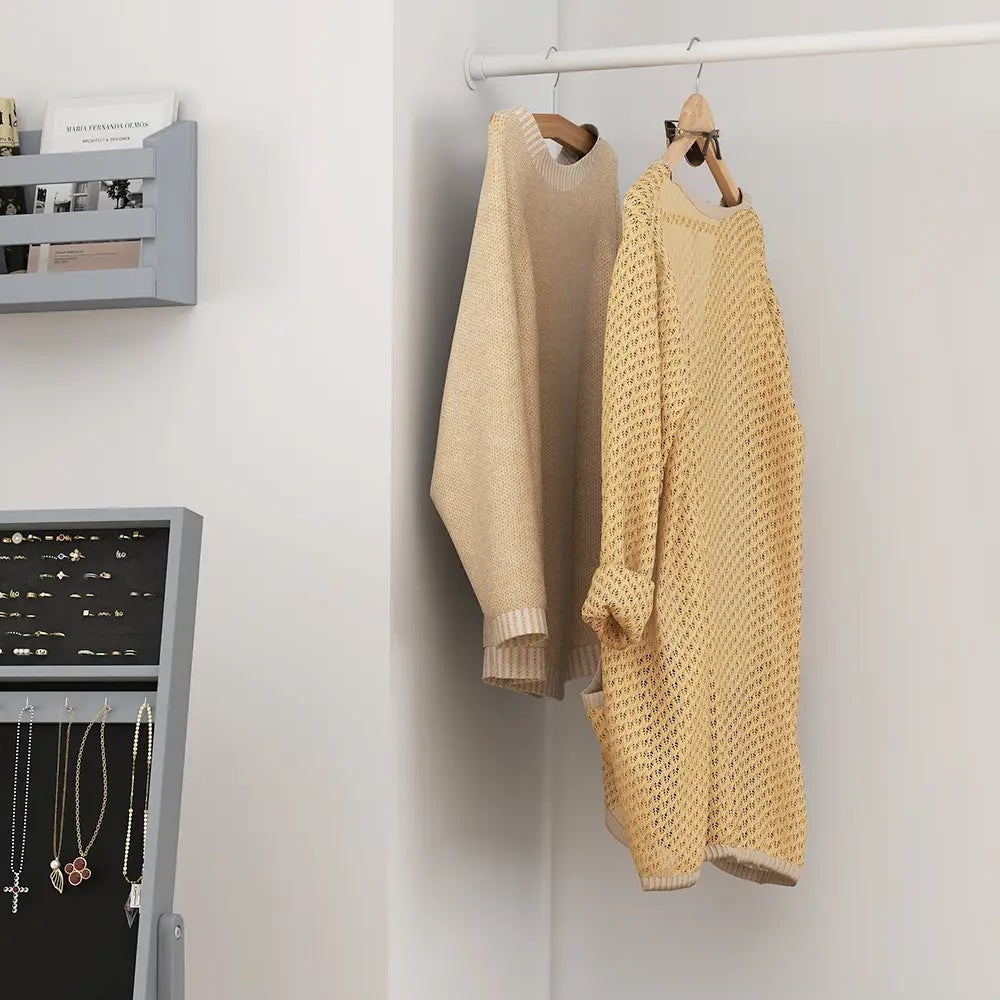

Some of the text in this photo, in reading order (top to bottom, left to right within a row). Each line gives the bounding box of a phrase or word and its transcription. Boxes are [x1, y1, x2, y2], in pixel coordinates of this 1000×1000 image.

[66, 121, 149, 133] MARIA FERNANDA OLMOS
